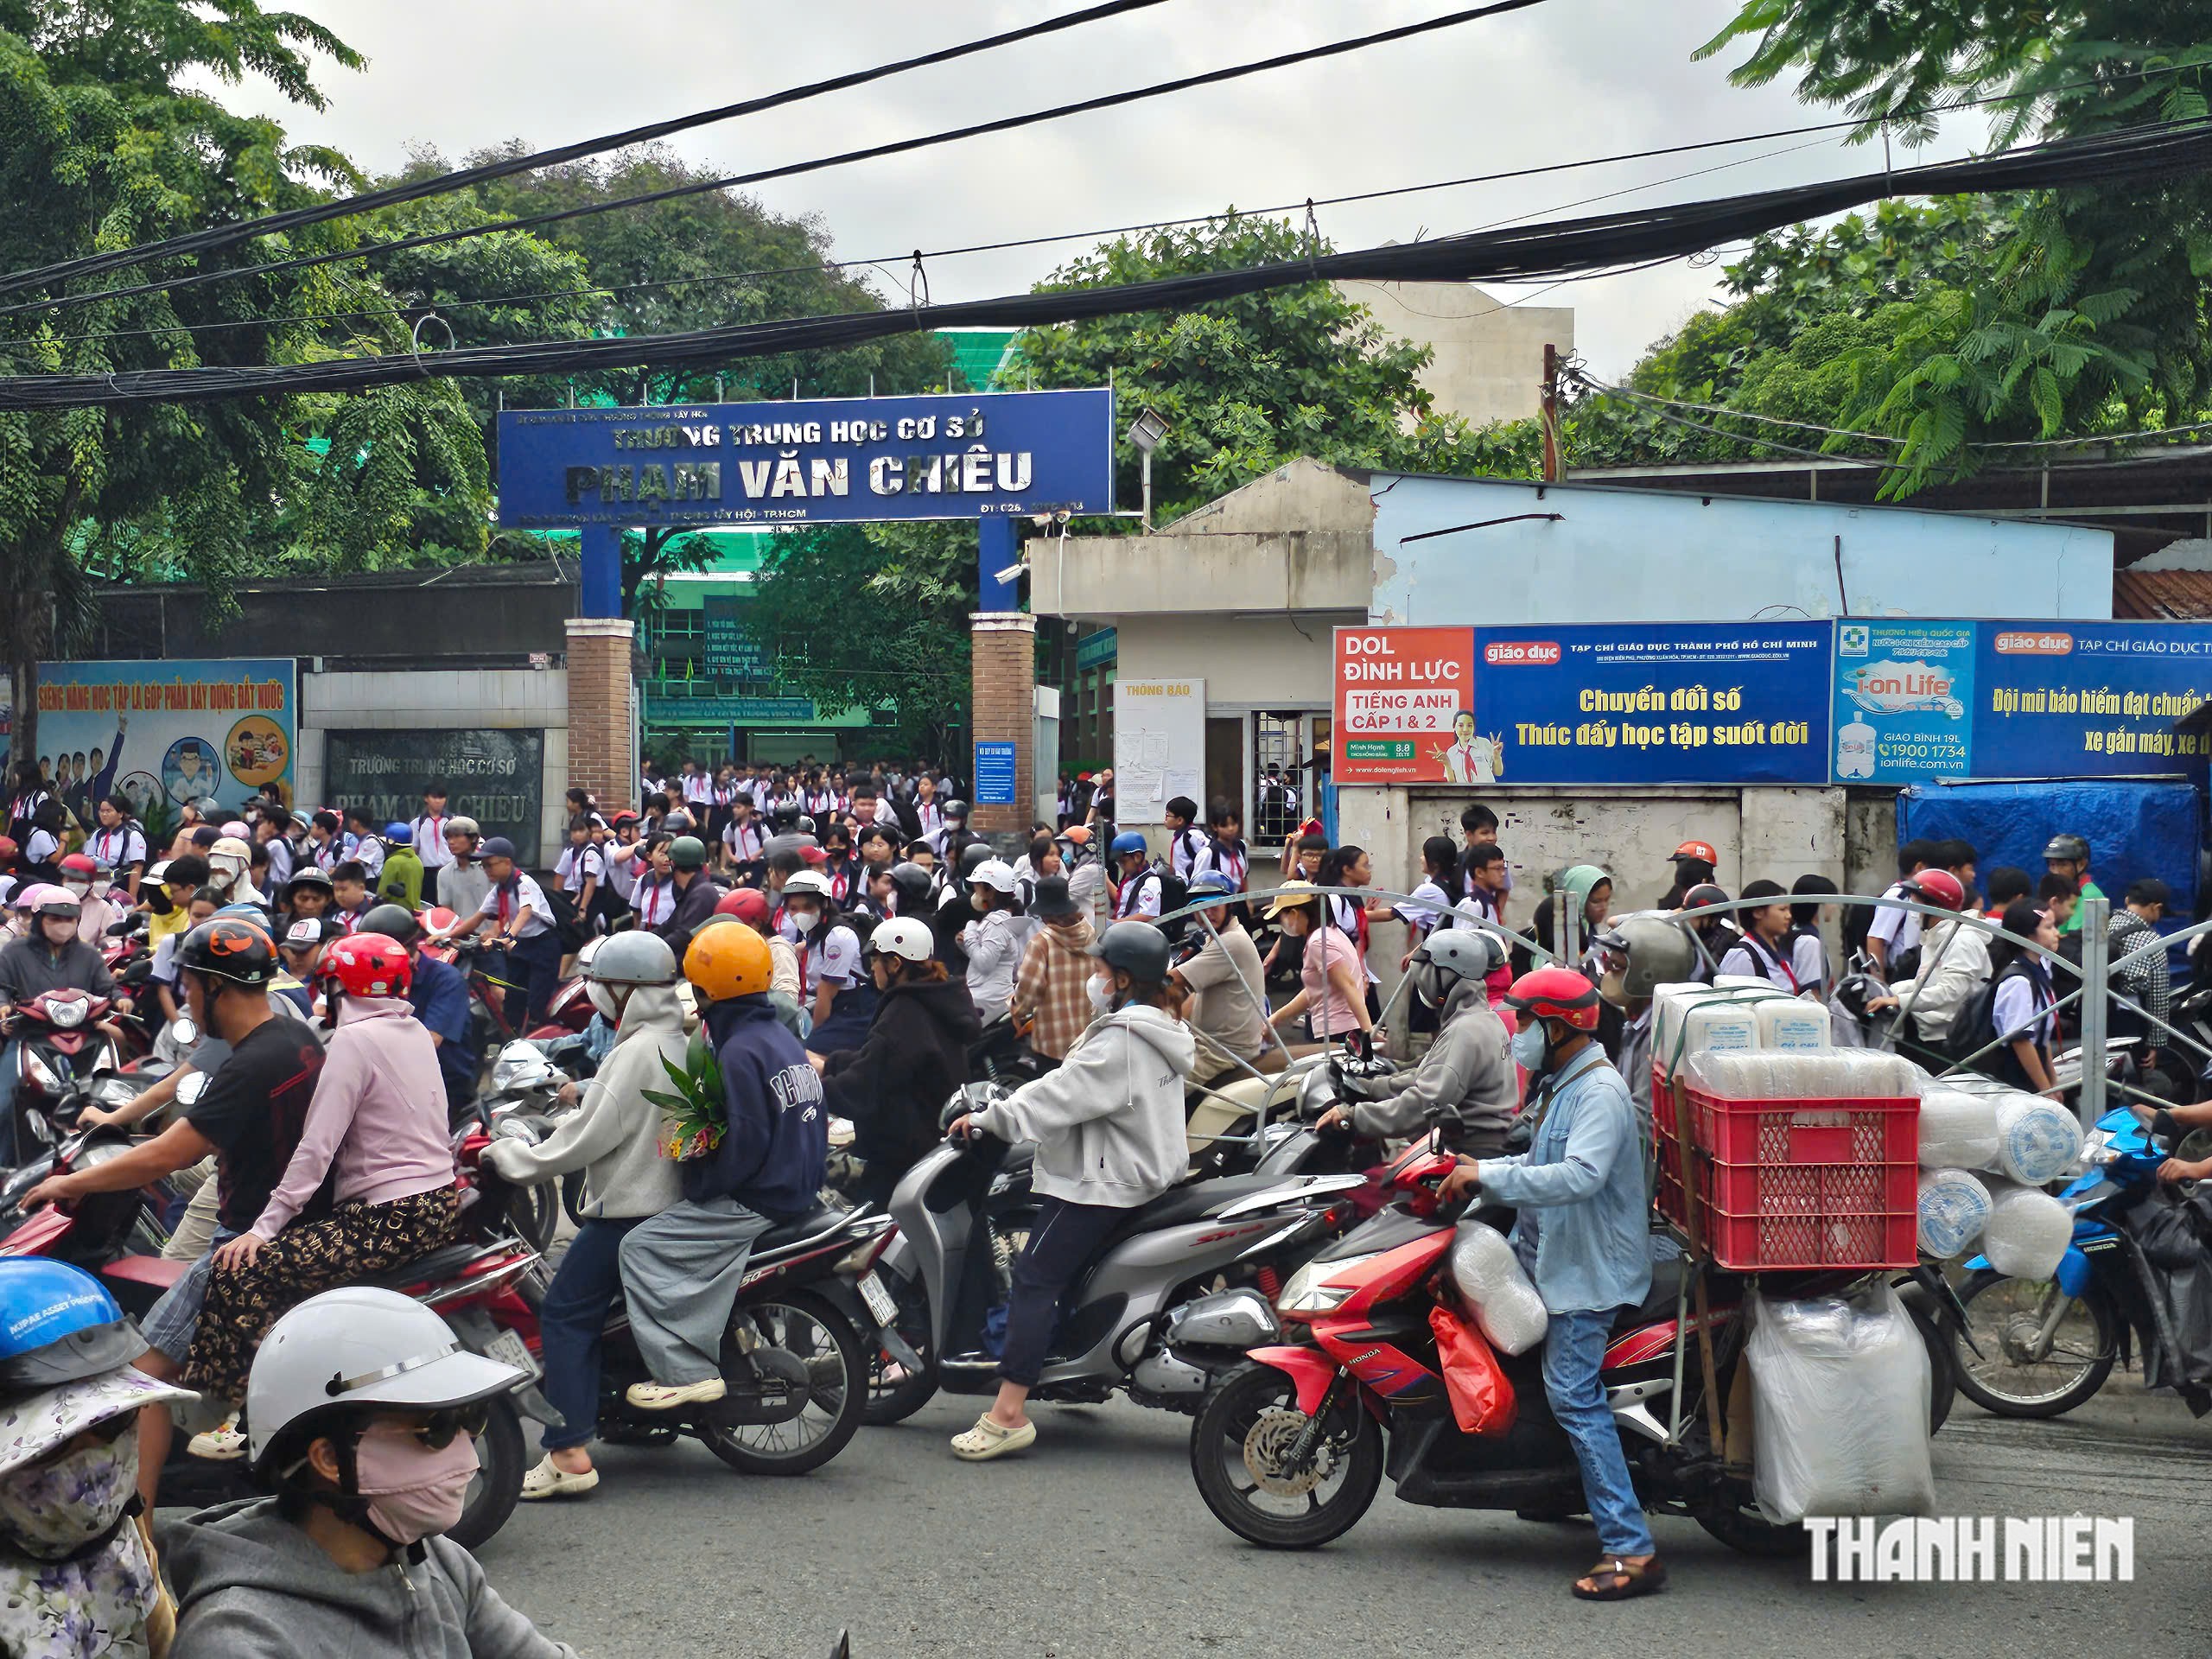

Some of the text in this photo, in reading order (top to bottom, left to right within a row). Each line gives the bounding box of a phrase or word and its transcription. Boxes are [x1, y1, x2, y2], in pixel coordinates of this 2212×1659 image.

[728, 422, 822, 446] TRUNG
[831, 420, 888, 447] HỌC
[897, 415, 937, 440] CƠ
[945, 408, 987, 438] SỞ
[566, 444, 1033, 512] PHẠM VĂN CHIÊU
[1345, 637, 1395, 655] DOL
[1570, 645, 1591, 653] TẠP
[1594, 643, 1615, 652] CHÍ
[1618, 642, 1643, 652] GIÁO
[1647, 644, 1670, 652] DỤC
[1674, 641, 1712, 651] THÀNH
[1715, 639, 1739, 650] PHỐ
[1742, 639, 1758, 649] HỒ
[1763, 639, 1783, 648] CHÍ
[1998, 634, 2069, 652] giáo dục
[2078, 639, 2101, 653] TẠP
[2106, 639, 2129, 652] CHÍ
[2132, 640, 2166, 653] GIÁO
[2170, 642, 2201, 656] DỤC
[1487, 644, 1558, 662] giáo dục
[1344, 658, 1460, 684] ĐÌNH LỰC
[1126, 682, 1191, 696] THÔNG BÁO
[1905, 674, 1950, 696] Life
[1352, 691, 1452, 709] TIẾNG ANH
[1580, 683, 1744, 714] Chuyển đổi số
[1993, 689, 2018, 718] Đội
[2021, 688, 2045, 712] mũ
[2048, 686, 2077, 714] bảo
[2081, 686, 2120, 715] hiểm
[2123, 690, 2150, 721] đạt
[1351, 711, 1437, 729] CẤP 1 & 2
[1516, 719, 1808, 750] Thúc đẩy học tập suốt đời
[1884, 733, 1961, 743] GIAO BÌNH 19L
[2085, 731, 2103, 752] xe
[2106, 724, 2135, 755] gắn
[2139, 728, 2175, 757] máy,
[2177, 734, 2196, 754] xe
[1395, 743, 1410, 753] 8.0
[1891, 745, 1966, 758] 1900 1734
[1880, 758, 1964, 770] ionlife.com.vn
[41, 1301, 70, 1318] ASSET
[1348, 1348, 1381, 1364] HONDA
